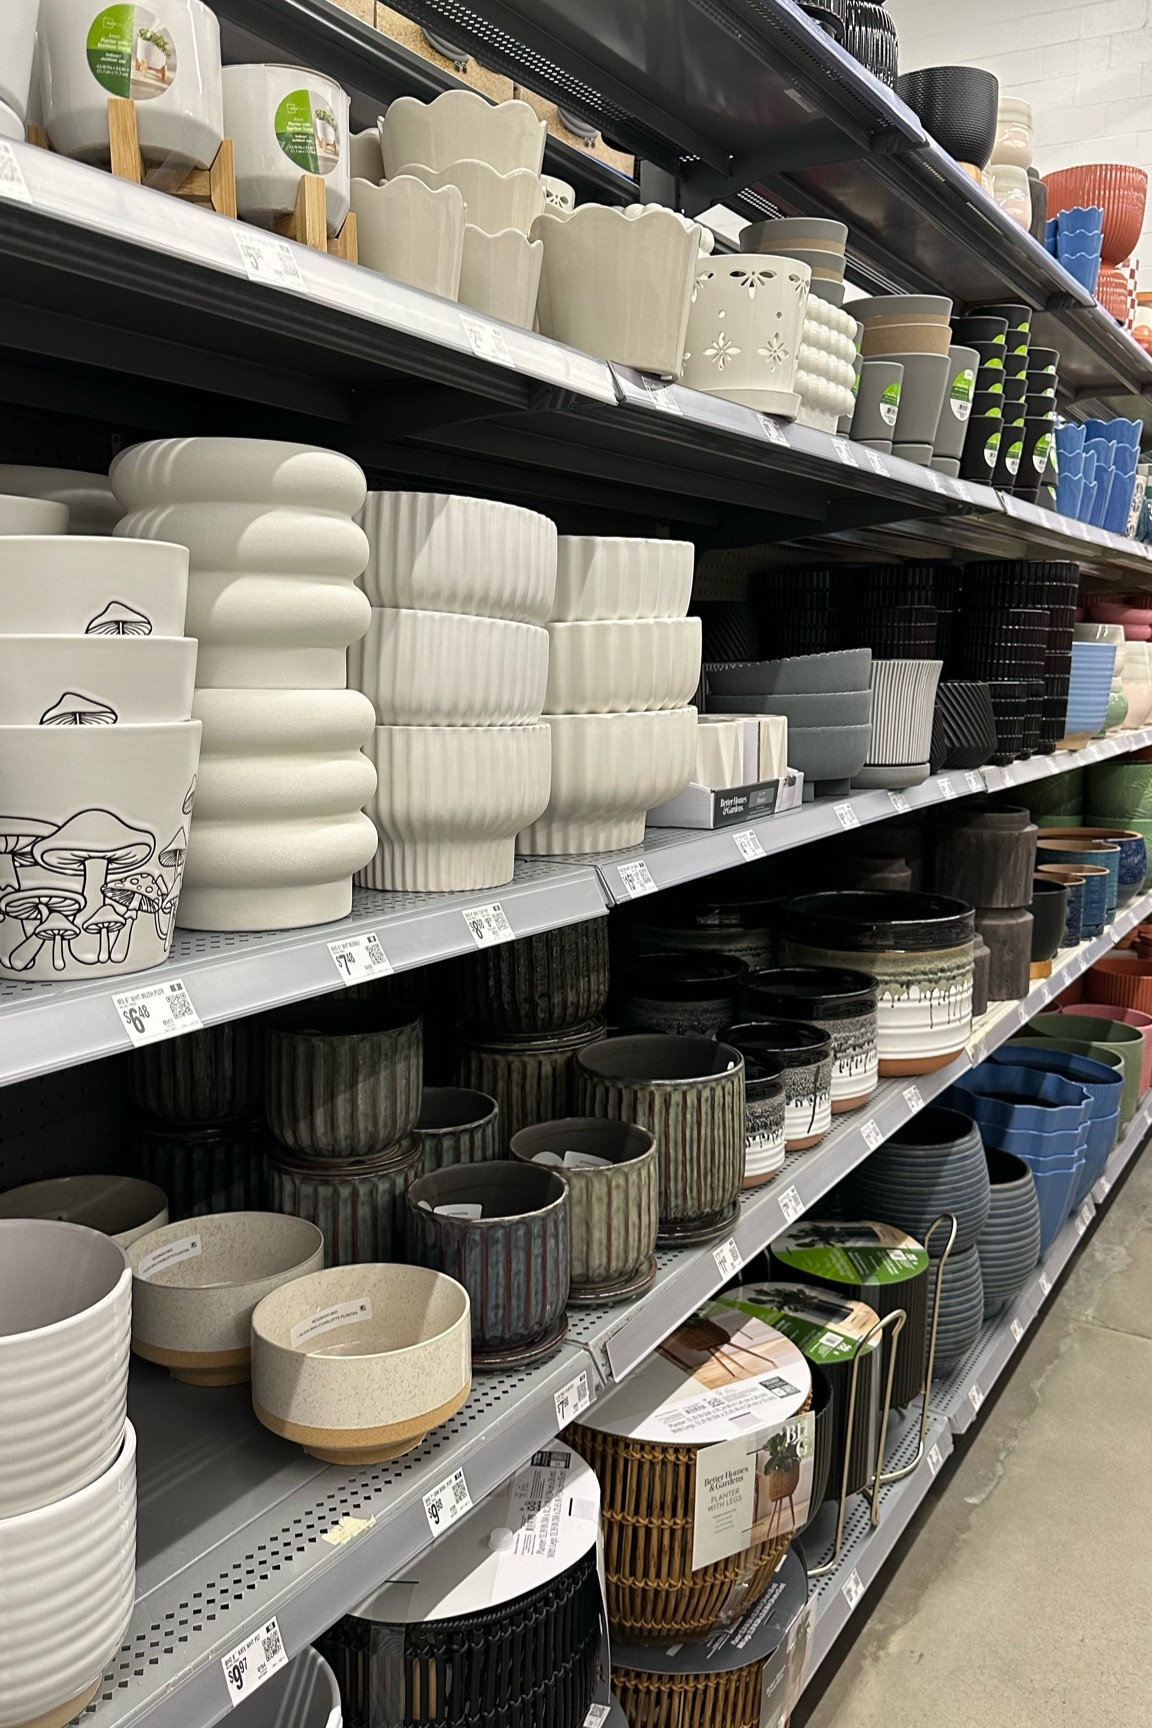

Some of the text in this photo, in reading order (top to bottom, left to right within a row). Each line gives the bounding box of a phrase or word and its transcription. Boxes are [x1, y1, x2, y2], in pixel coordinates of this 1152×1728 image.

[341, 1311, 358, 1319] PLANTER
[704, 1466, 749, 1486] Better Homes
[714, 1476, 744, 1490] Gardens
[711, 1488, 740, 1503] PLANTER
[707, 1495, 742, 1512] WITH LEGS
